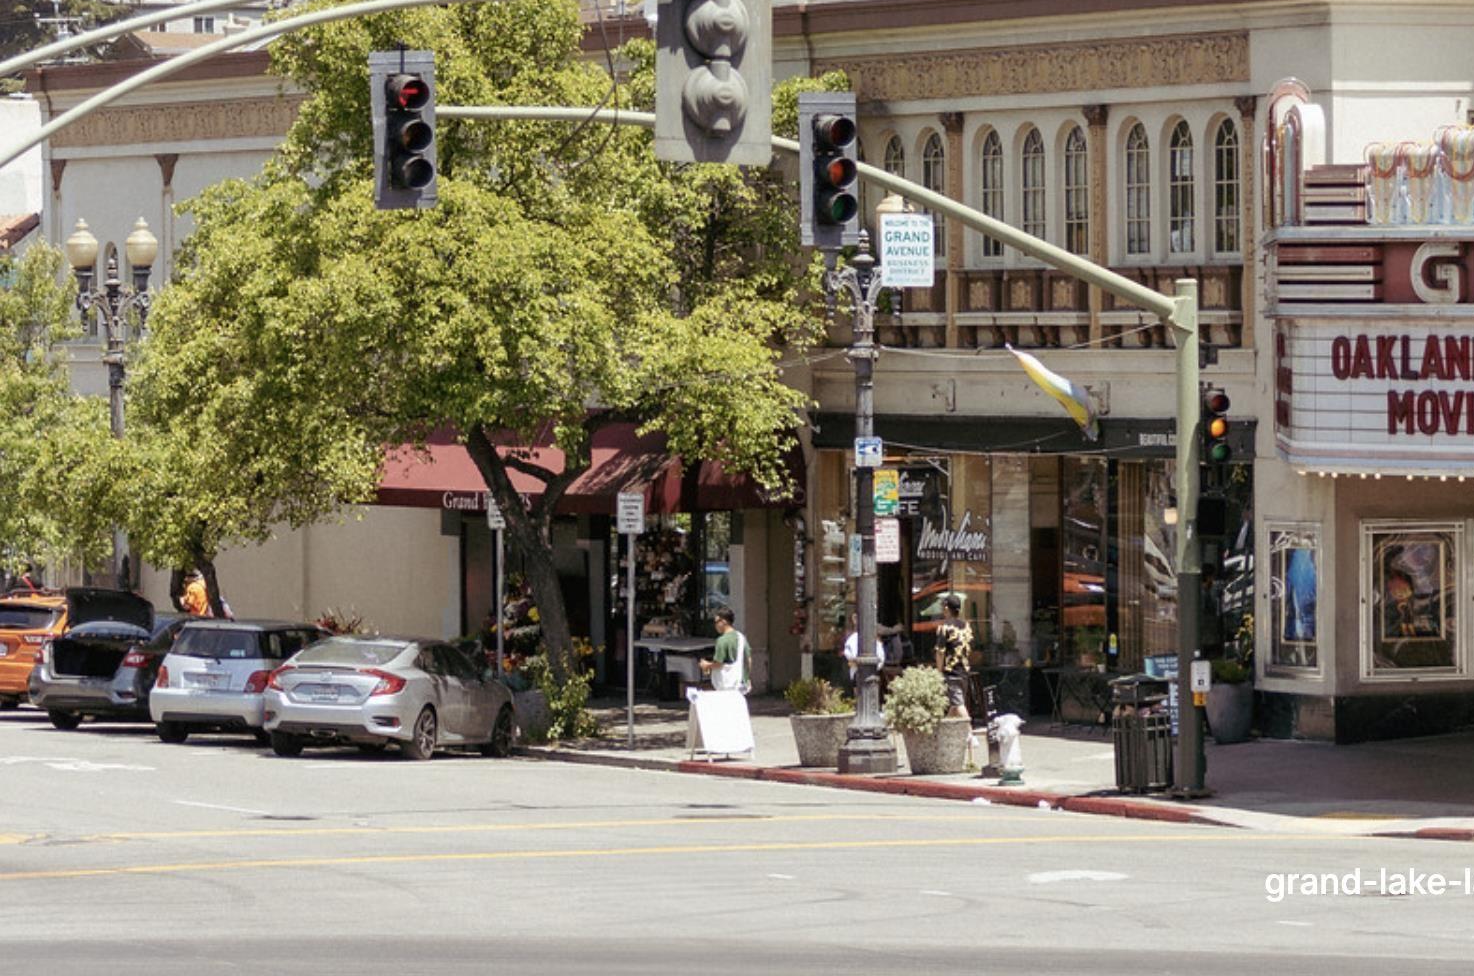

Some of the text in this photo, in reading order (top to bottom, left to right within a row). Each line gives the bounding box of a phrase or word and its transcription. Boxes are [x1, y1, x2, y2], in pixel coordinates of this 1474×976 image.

[885, 231, 930, 242] GRAND
[886, 246, 930, 256] AVENUE
[442, 491, 479, 510] Grand
